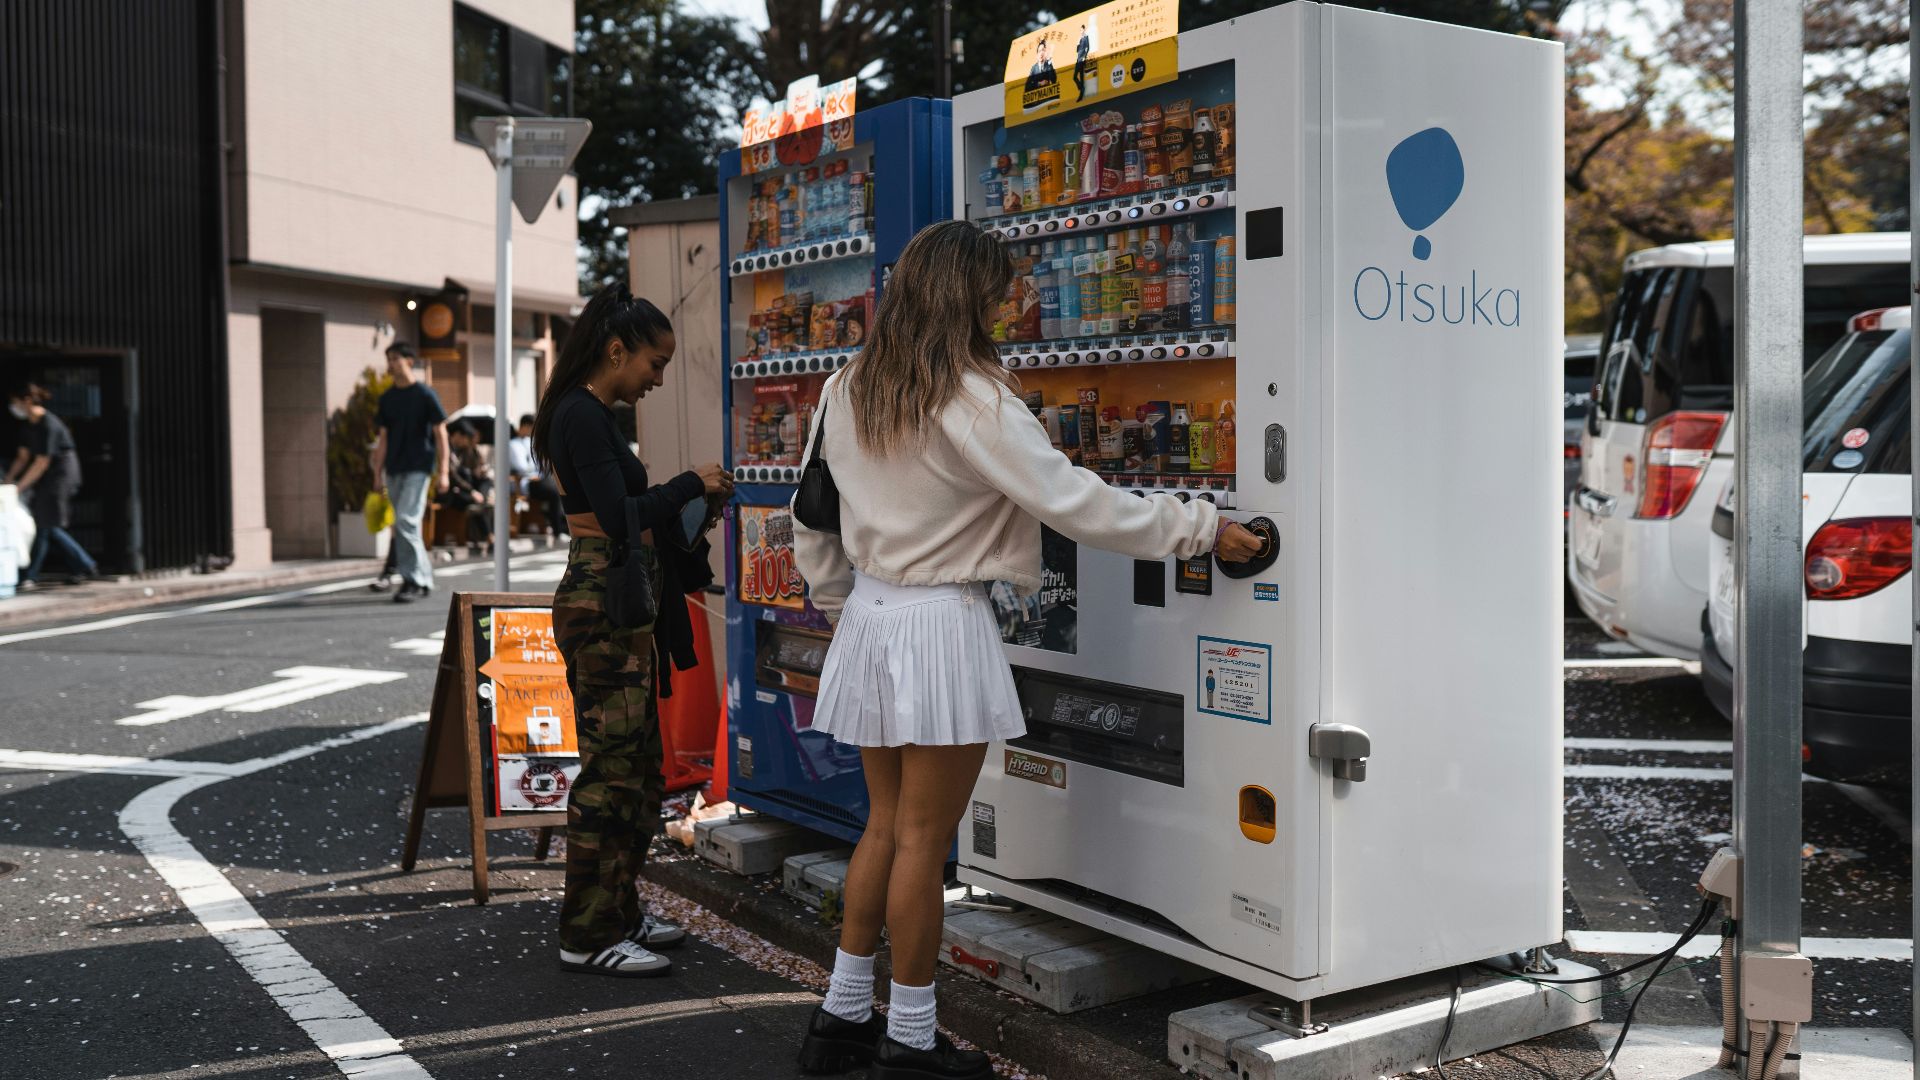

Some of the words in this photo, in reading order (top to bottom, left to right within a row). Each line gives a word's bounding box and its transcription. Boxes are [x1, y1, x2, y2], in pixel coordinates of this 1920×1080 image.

[1192, 152, 1209, 161] LACK
[1193, 253, 1203, 321] POCARI
[1354, 267, 1519, 327] Otsuka
[517, 638, 557, 651] コーヒ
[1224, 679, 1254, 689] 425201
[504, 687, 538, 702] TAKE
[550, 688, 571, 702] OU
[525, 766, 564, 781] COFFEE
[1008, 756, 1048, 776] HYBRID
